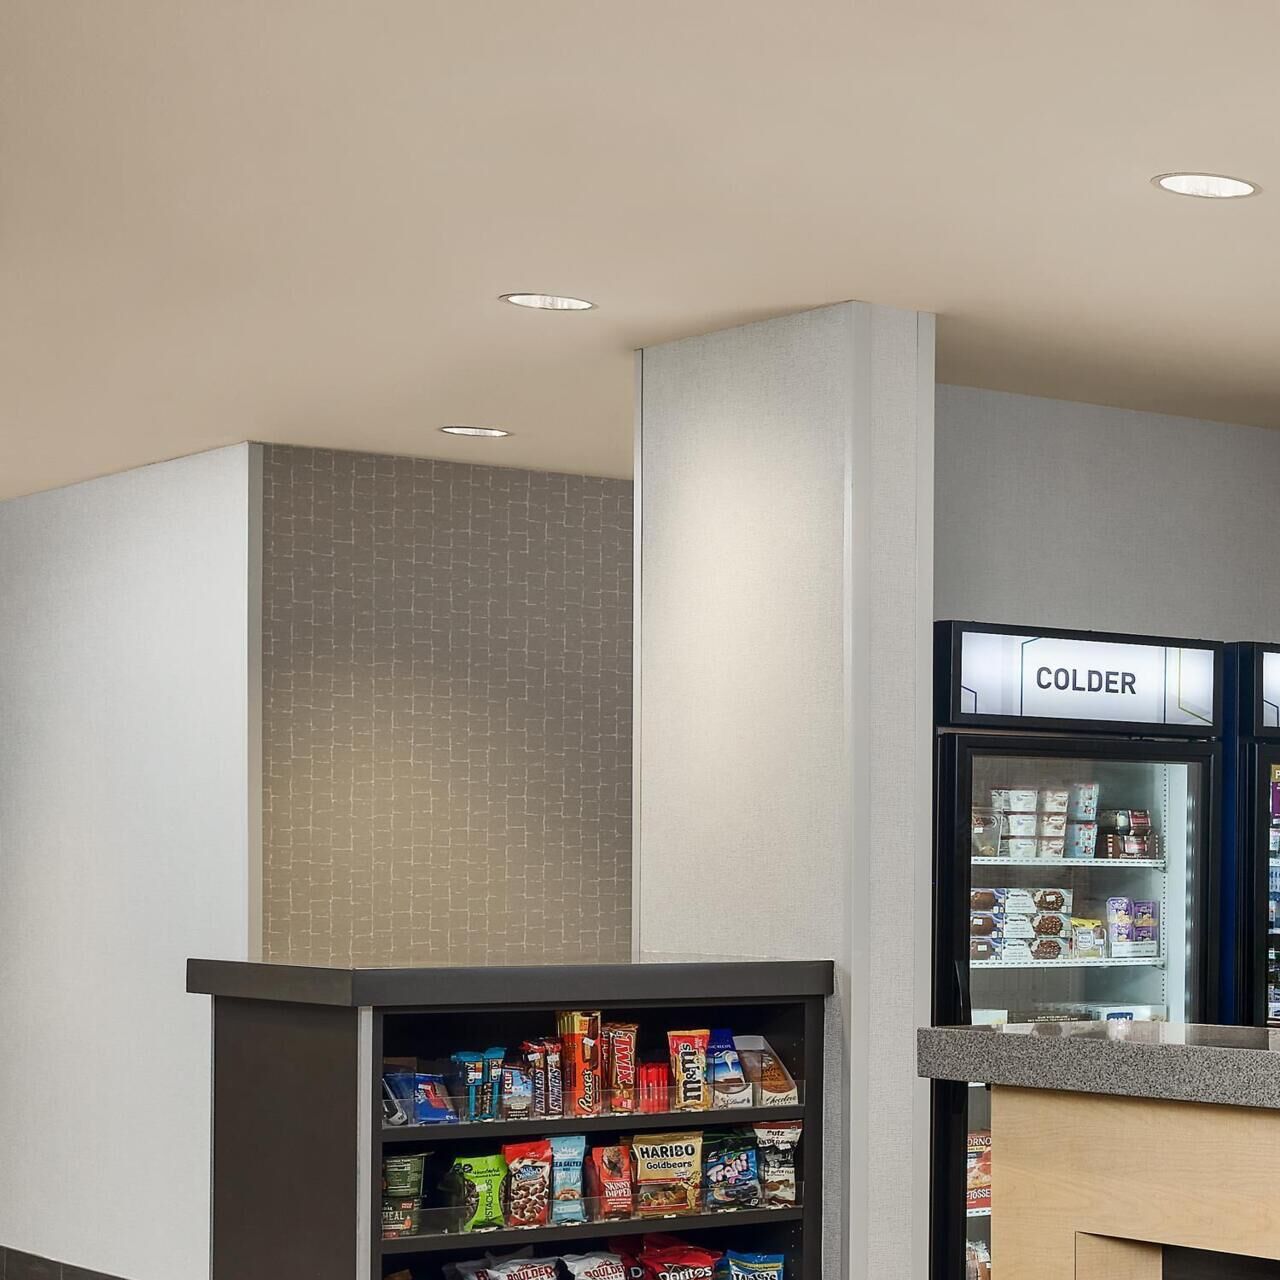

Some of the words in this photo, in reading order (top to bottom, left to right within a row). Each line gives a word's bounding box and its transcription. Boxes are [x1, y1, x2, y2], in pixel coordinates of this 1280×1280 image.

[1036, 666, 1137, 695] COLDER
[639, 1144, 696, 1159] HARIBO
[646, 1160, 693, 1170] Goldbears
